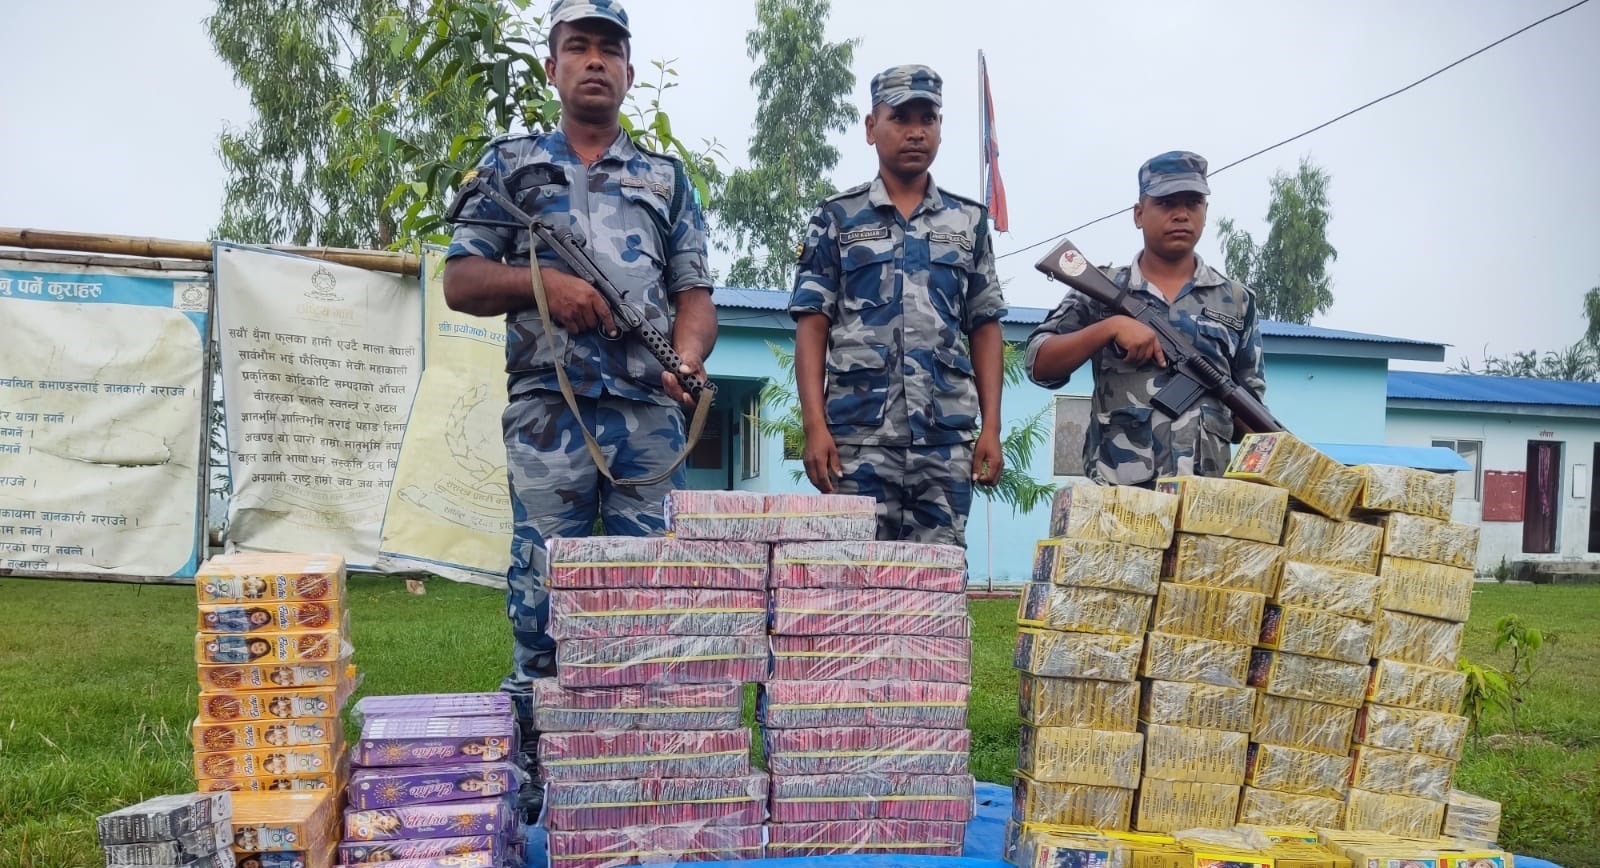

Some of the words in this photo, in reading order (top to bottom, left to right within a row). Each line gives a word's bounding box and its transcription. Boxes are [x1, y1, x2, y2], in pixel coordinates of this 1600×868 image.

[18, 276, 44, 295] पर्ने
[275, 333, 306, 345] फूलका
[312, 336, 331, 347] हामी
[337, 338, 358, 351] एउटै
[362, 343, 384, 354] माला
[388, 345, 415, 357] नेपाली
[238, 348, 275, 361] सार्वभौम
[280, 353, 295, 365] भई
[299, 353, 341, 369] फैलिएका
[38, 380, 99, 394] कमाण्डरलाई
[103, 382, 146, 395] जानकारी
[150, 385, 186, 398] गराउने
[241, 369, 281, 383] प्रकृतिका
[334, 379, 374, 392] सम्पदाको
[298, 396, 324, 408] रगतले
[329, 399, 359, 410] स्वतन्त्र
[362, 402, 370, 413] र
[374, 403, 397, 413] अटल
[16, 412, 39, 423] यात्रा
[240, 410, 276, 425] ज्ञानभूमि
[281, 411, 324, 427] शान्तिभूमि
[328, 418, 352, 431] तराई
[245, 433, 274, 443] अखण्ड
[277, 432, 291, 443] यो
[293, 433, 316, 445] प्यारो
[320, 437, 340, 448] हाम्रो
[343, 439, 381, 453] मातृभूमि
[238, 453, 256, 466] बहुल
[261, 450, 282, 464] जाति
[286, 454, 309, 464] भाषा
[311, 454, 326, 465] धर्म
[367, 461, 384, 472] छन्
[251, 471, 287, 484] अग्रगामी
[291, 474, 312, 487] राष्ट्र
[314, 474, 332, 486] हाम्रो
[337, 477, 353, 486] जय
[357, 479, 373, 488] जय
[40, 511, 86, 524] जानकारी
[91, 514, 128, 527] गराउने
[32, 544, 50, 555] पात्र
[55, 544, 84, 556] नबन्ने
[7, 558, 49, 570] नल्याउने
